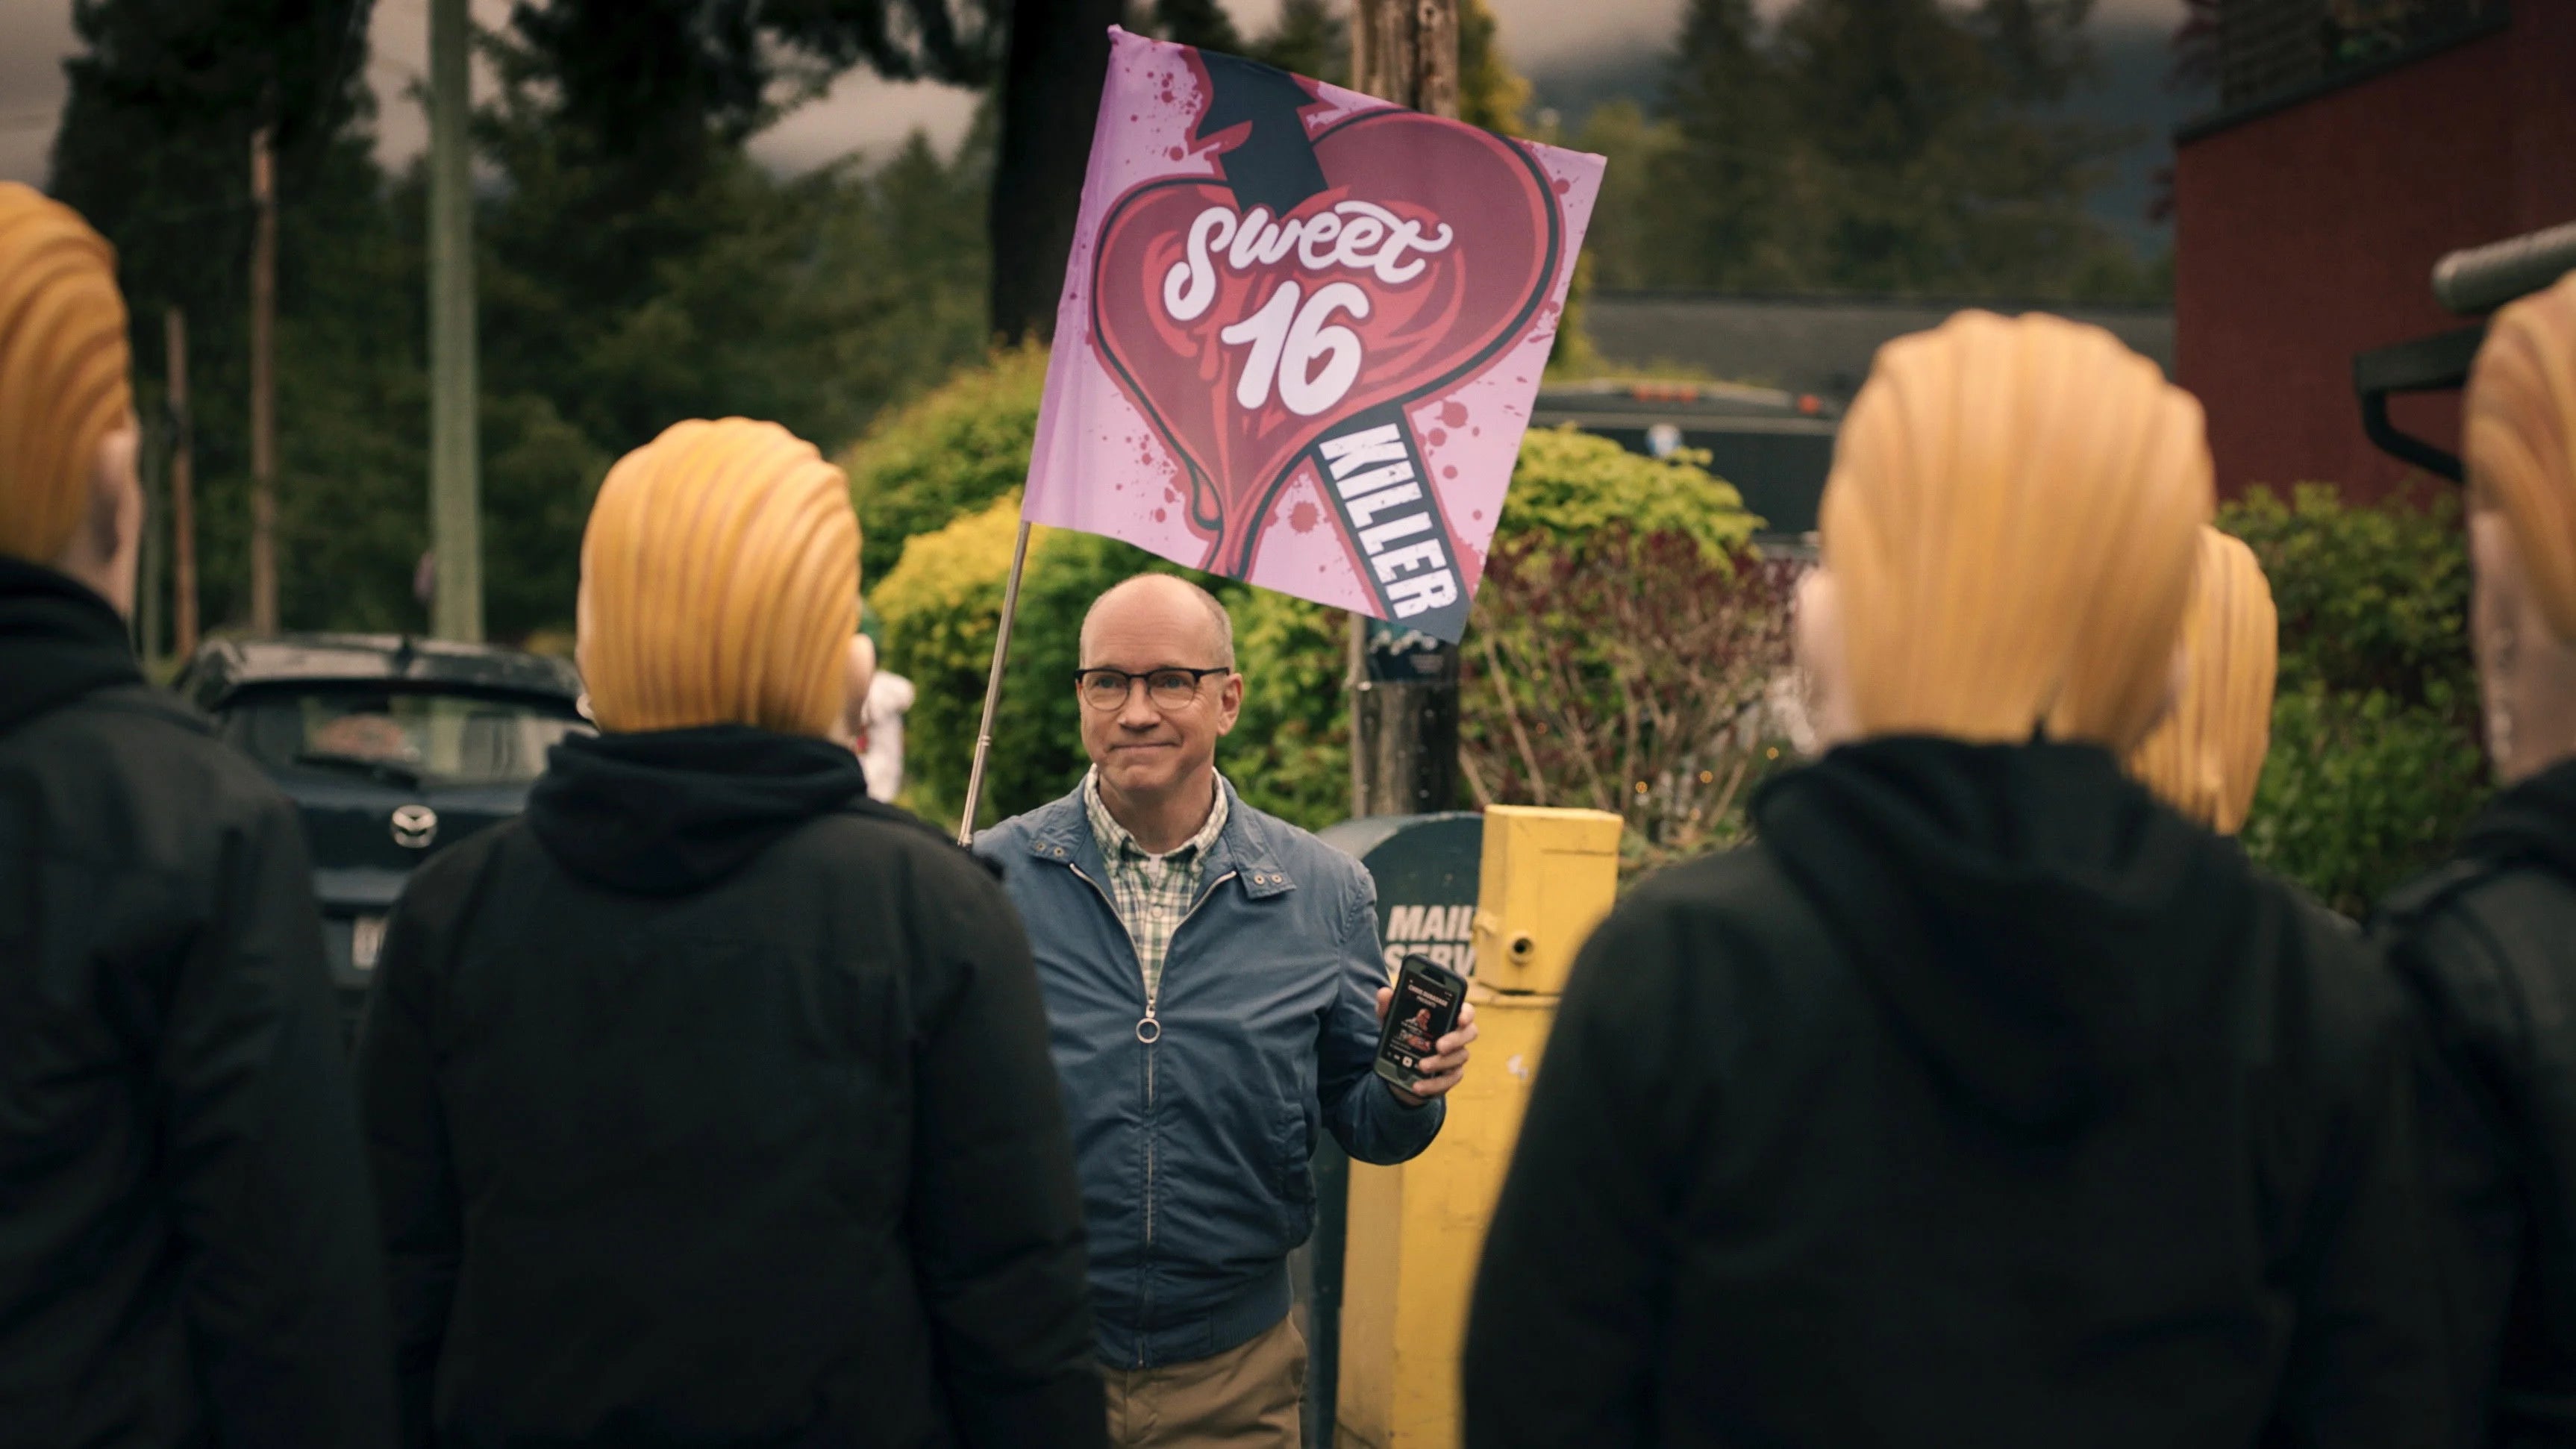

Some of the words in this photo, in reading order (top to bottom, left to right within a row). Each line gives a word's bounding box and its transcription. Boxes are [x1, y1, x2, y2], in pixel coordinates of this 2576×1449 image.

[1221, 280, 1370, 416] 16
[1319, 422, 1459, 619] KILLER
[1386, 905, 1473, 941] MAIL
